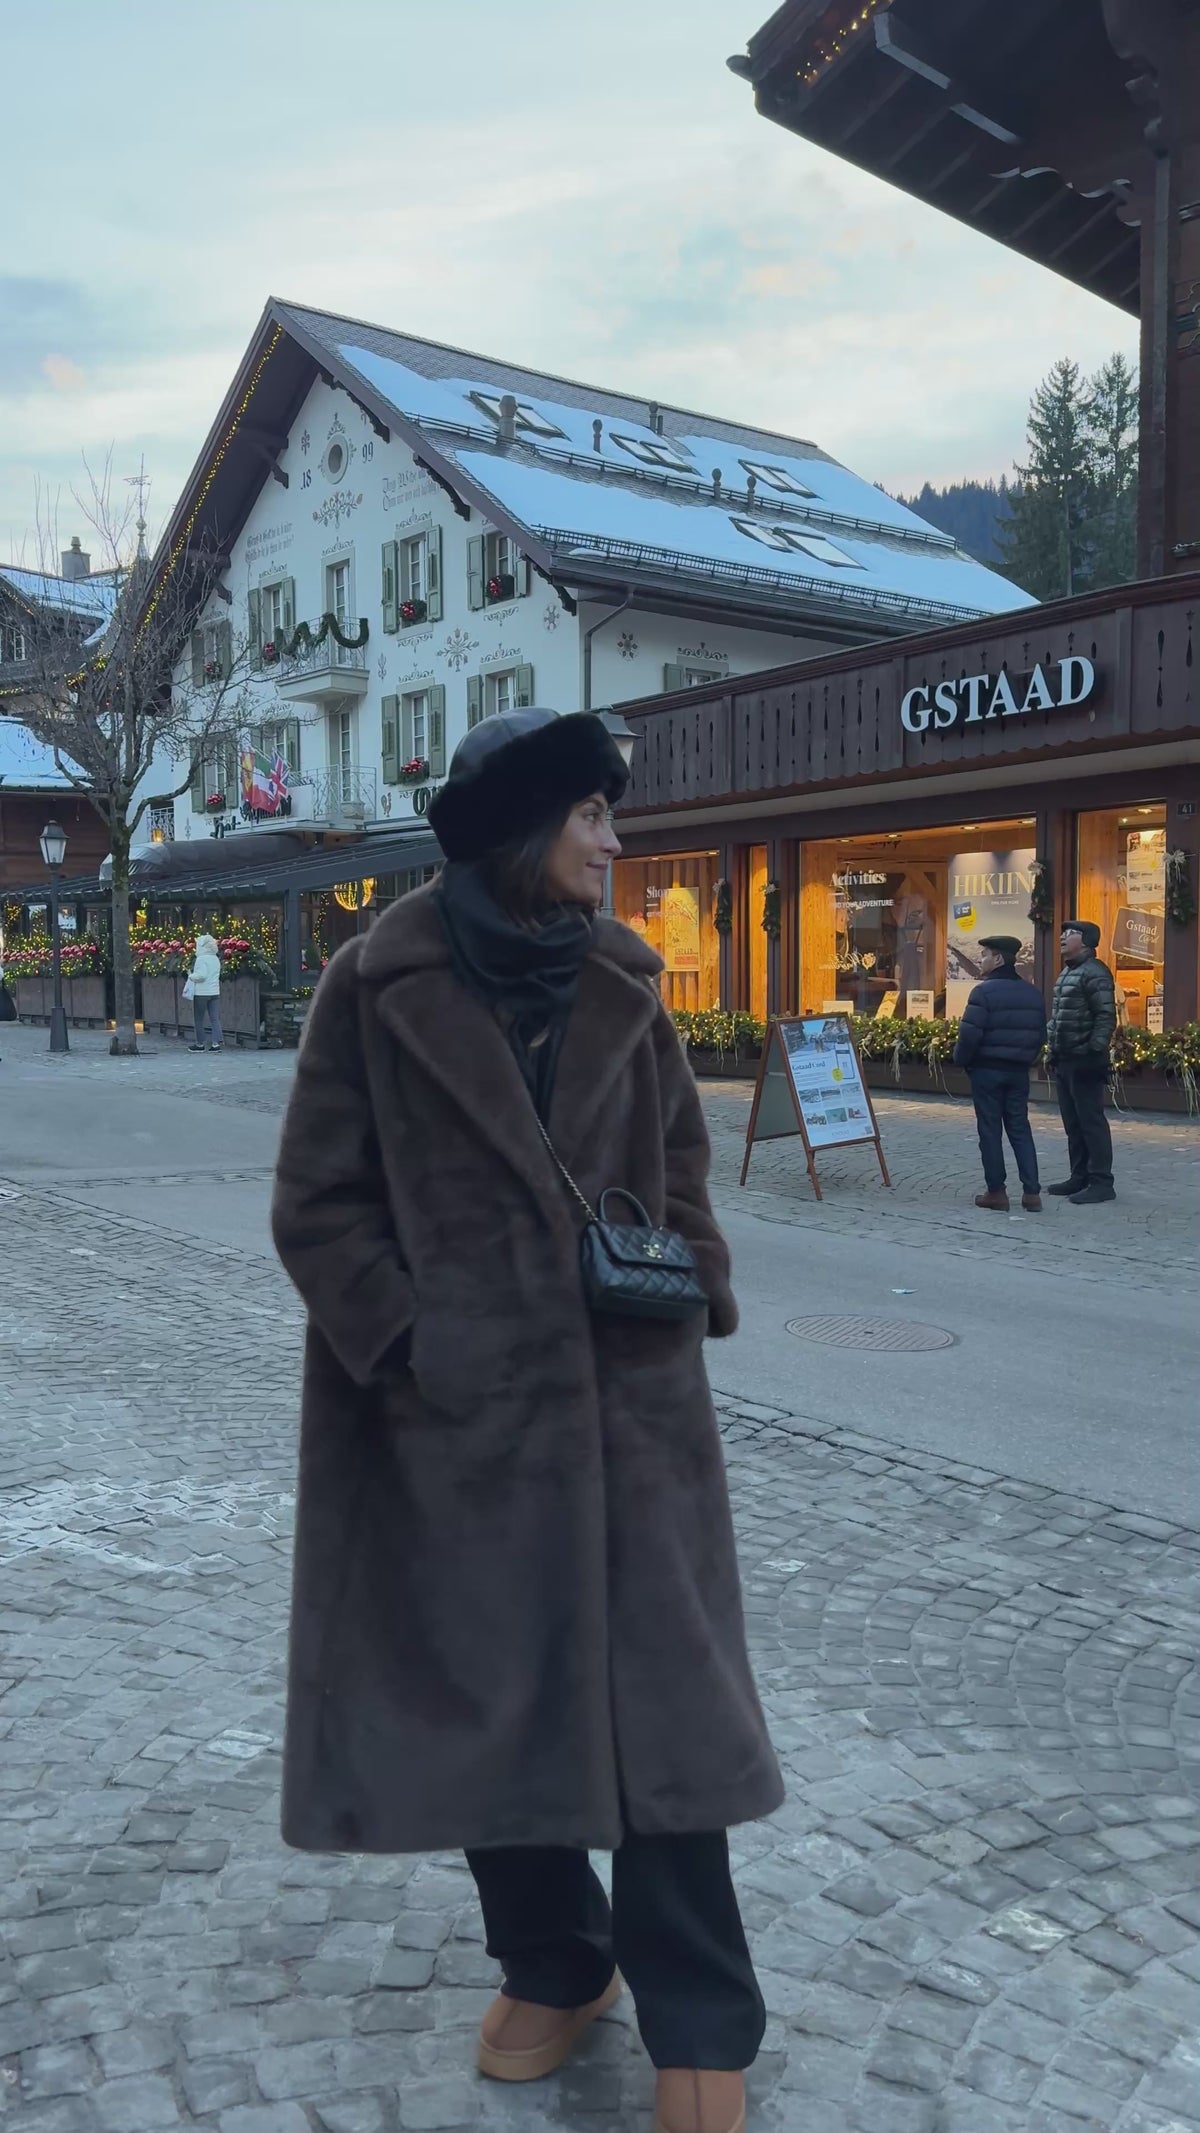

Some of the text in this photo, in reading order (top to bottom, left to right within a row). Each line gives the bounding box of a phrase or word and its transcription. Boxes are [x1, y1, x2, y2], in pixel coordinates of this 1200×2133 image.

[362, 441, 374, 463] 99
[901, 656, 1094, 732] GSTAAD
[1182, 804, 1192, 813] 41
[829, 870, 888, 887] Activities
[859, 899, 895, 908] ADVENTURE
[1126, 919, 1157, 936] Gstaad
